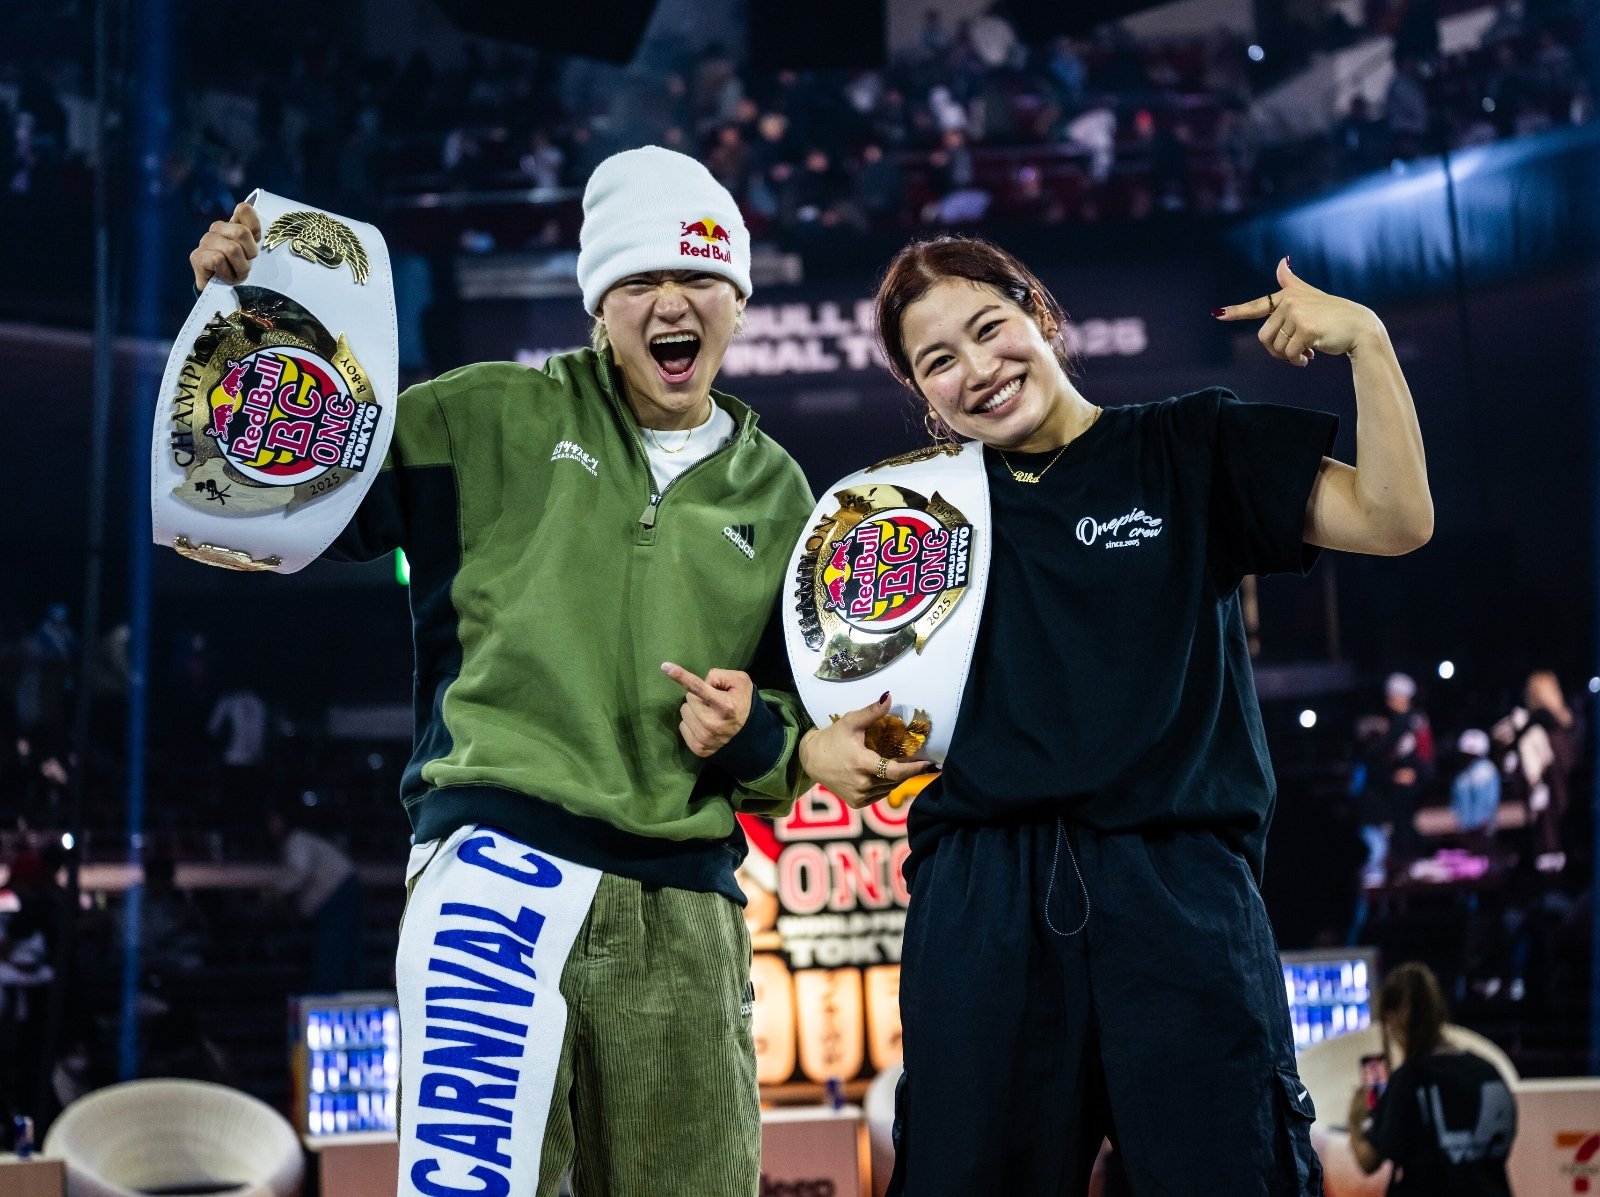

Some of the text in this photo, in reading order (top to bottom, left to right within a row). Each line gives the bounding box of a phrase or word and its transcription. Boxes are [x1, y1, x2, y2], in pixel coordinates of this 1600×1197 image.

[680, 241, 710, 258] Red
[171, 311, 233, 467] CHAMPION
[340, 358, 367, 394] B-BOY
[265, 383, 322, 458] BC
[311, 394, 355, 465] ONE
[341, 402, 366, 468] WORLD FINAL
[350, 405, 378, 469] TOKYO
[310, 472, 341, 496] 2025
[724, 526, 755, 559] adidas
[919, 530, 949, 592] ONE
[946, 527, 959, 589] WORLD FINAL
[954, 526, 970, 586] TOKYO
[1128, 526, 1163, 538] crew
[878, 536, 919, 599] BC
[927, 597, 951, 627] 2025
[410, 902, 547, 1197] CARNIVAL
